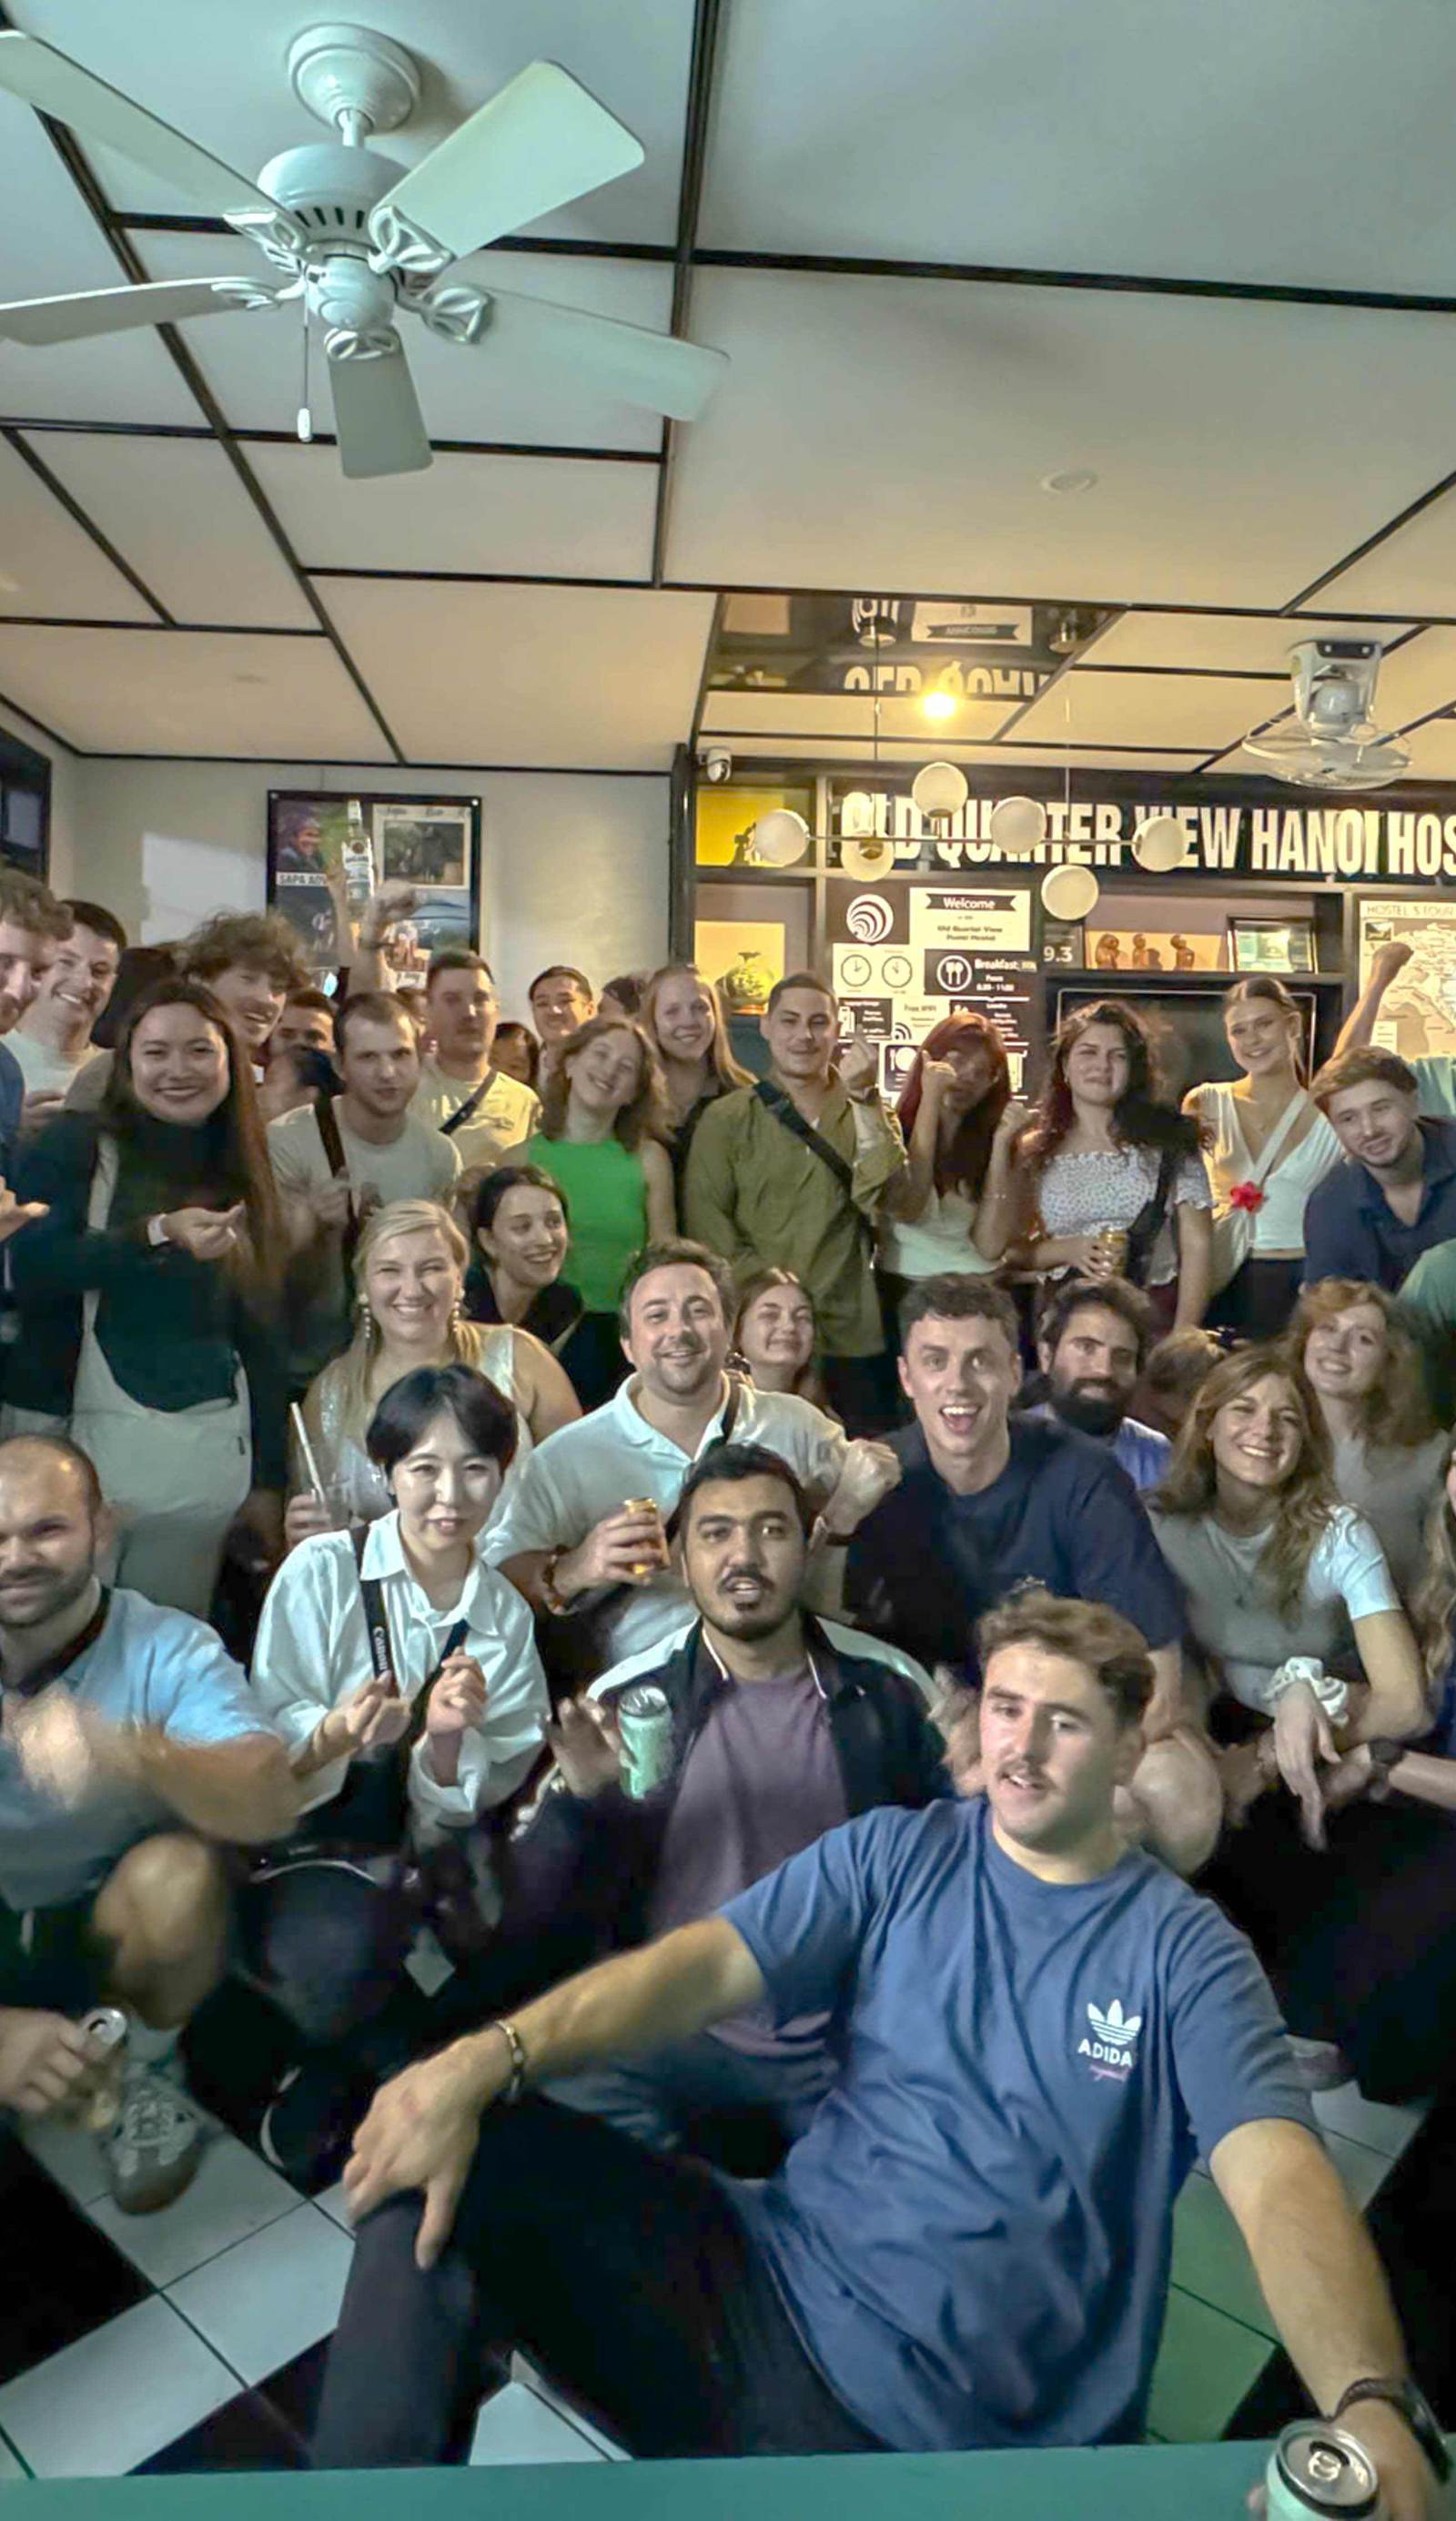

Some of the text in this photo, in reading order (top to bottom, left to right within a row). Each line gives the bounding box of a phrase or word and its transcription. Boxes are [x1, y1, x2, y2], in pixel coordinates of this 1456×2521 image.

[935, 797, 1122, 868] QUTER
[1135, 805, 1241, 869] EW
[1251, 808, 1380, 876] HANOI
[943, 896, 996, 909] Welcome
[1043, 946, 1074, 963] 9.3
